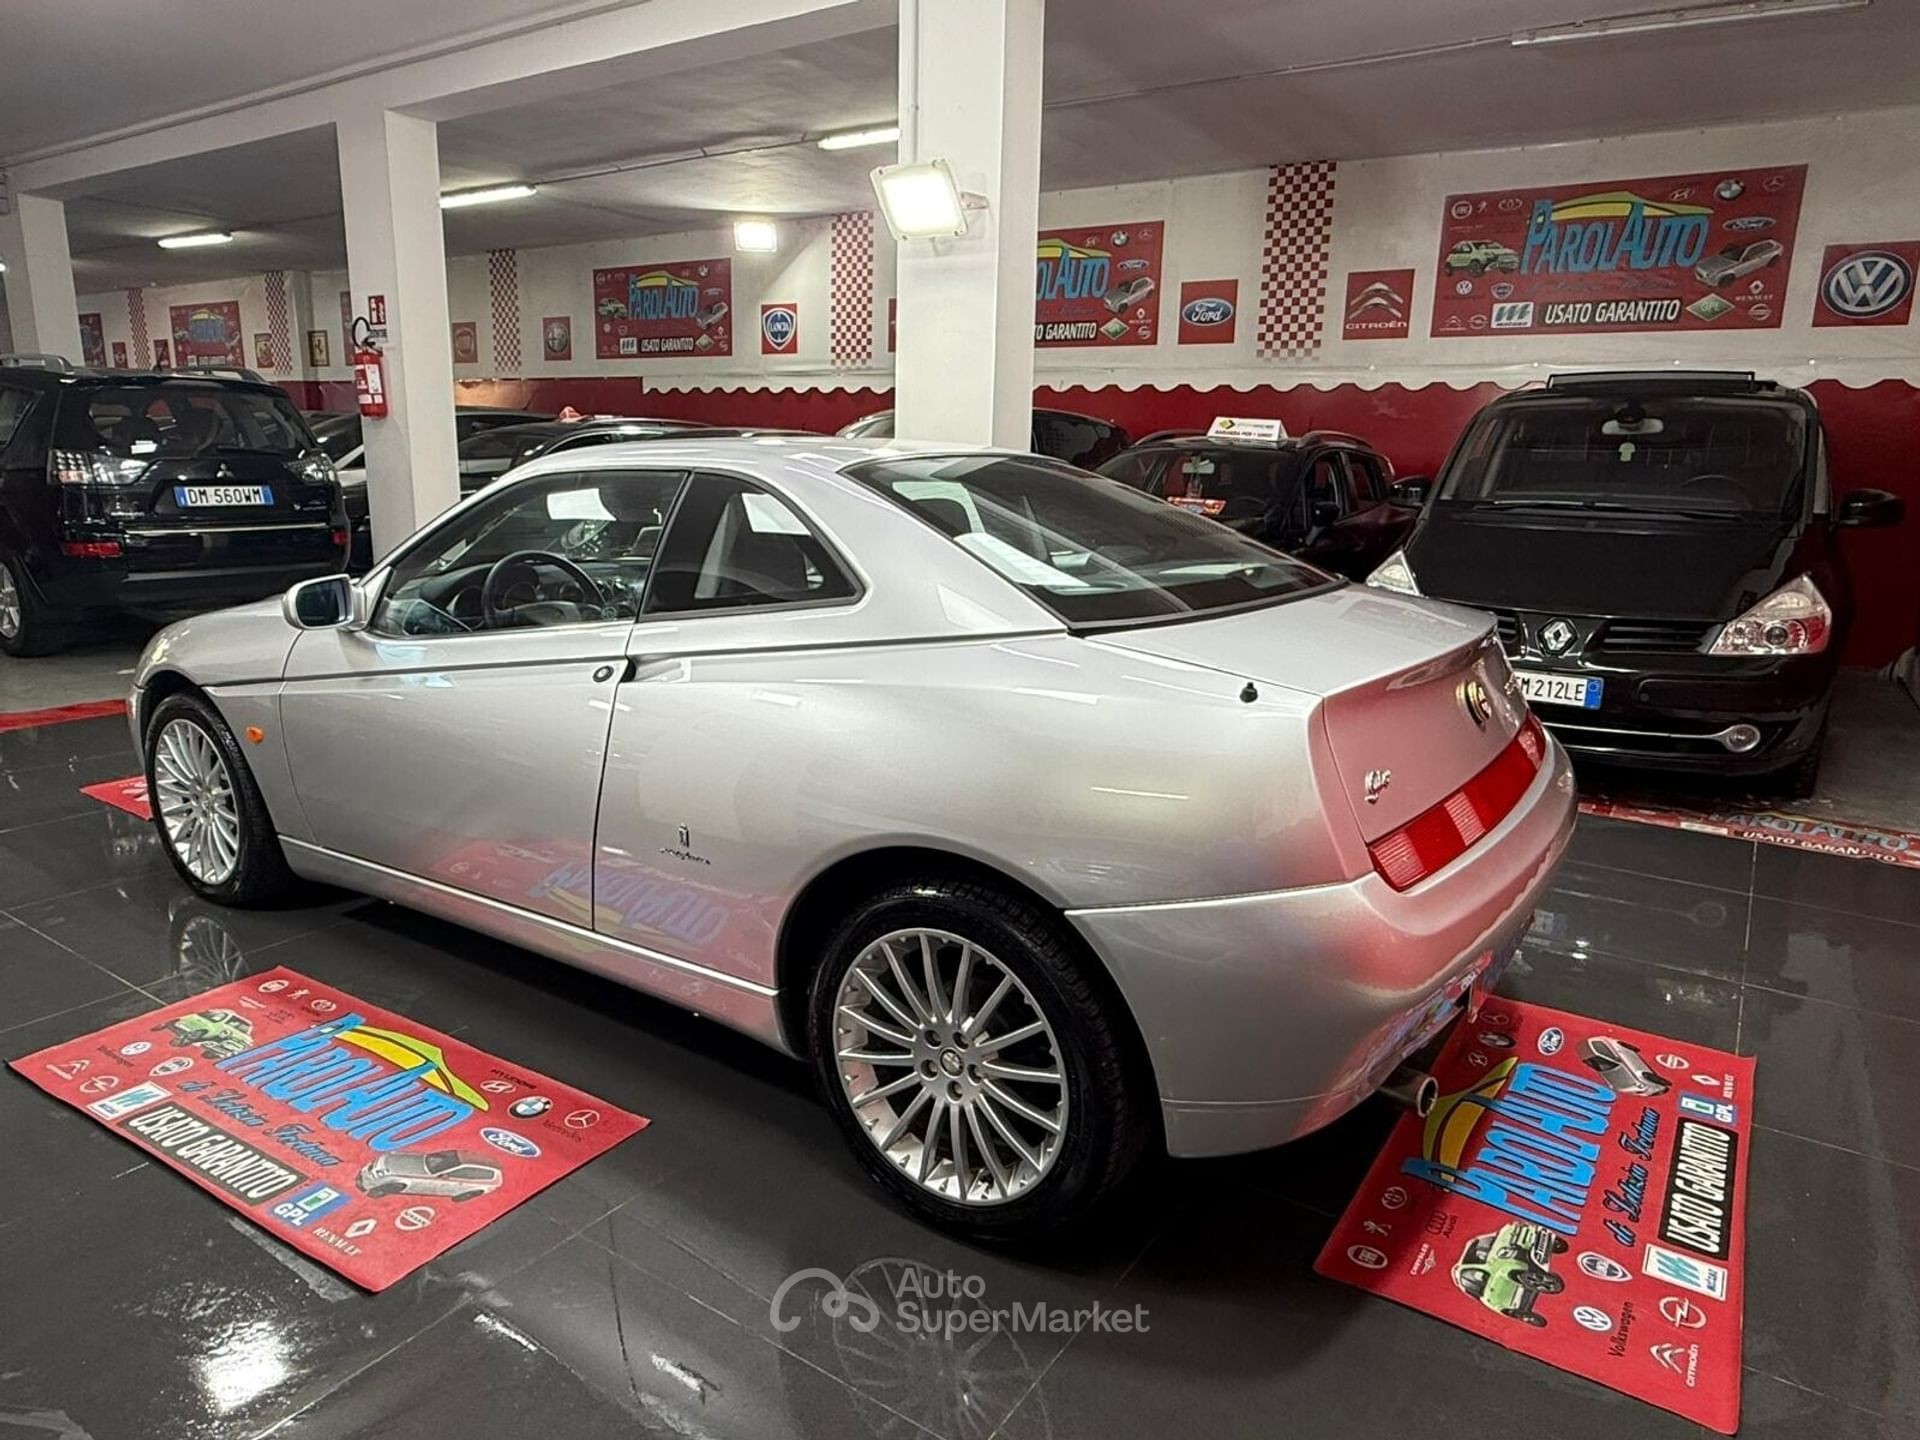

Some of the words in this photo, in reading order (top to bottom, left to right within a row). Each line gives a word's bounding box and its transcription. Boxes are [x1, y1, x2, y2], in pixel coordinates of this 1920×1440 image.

[1192, 303, 1224, 321] Ford
[1545, 302, 1591, 324] USATO
[1595, 299, 1680, 322] GARANTITO
[1045, 322, 1097, 340] GARANTITO
[641, 339, 659, 352] USATO
[661, 338, 693, 351] GARANTITO
[188, 489, 208, 504] DM
[214, 488, 262, 503] 560WM
[1516, 677, 1530, 694] M
[1534, 680, 1584, 701] 212LE
[1743, 831, 1795, 845] USATO
[177, 1080, 217, 1093] di
[1714, 1104, 1733, 1123] GPL
[128, 1106, 211, 1156] USATO
[177, 1134, 298, 1199] GARANTITO
[488, 1132, 531, 1154] Ford
[1675, 1121, 1731, 1201] GARANTITO
[274, 1203, 310, 1226] GPL
[1443, 1214, 1458, 1239] Audi
[1666, 1193, 1724, 1253] USATO
[313, 1227, 362, 1256] RENAULT
[1604, 1218, 1637, 1246] di
[1410, 1243, 1430, 1276] CHRYSLER
[1608, 1302, 1636, 1357] Volkswagen
